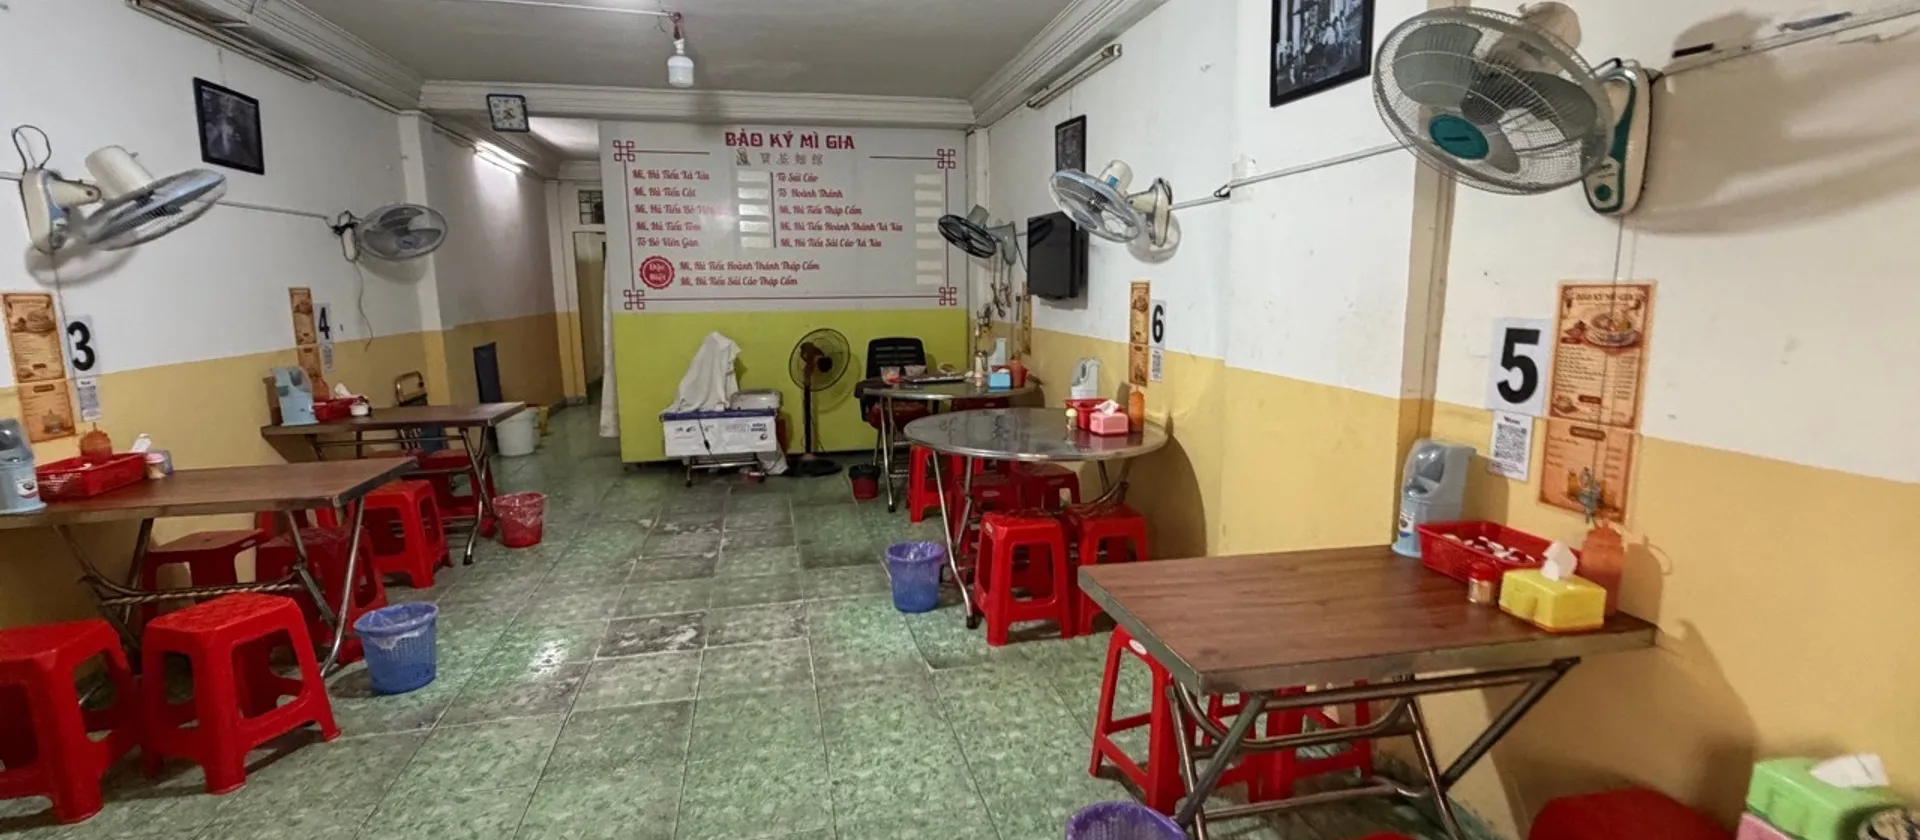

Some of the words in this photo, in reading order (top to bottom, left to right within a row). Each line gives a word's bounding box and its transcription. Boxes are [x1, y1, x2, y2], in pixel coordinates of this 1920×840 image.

[725, 128, 763, 147] BẢO
[770, 130, 793, 149] KÝ
[800, 131, 819, 149] MÌ
[826, 135, 855, 150] GIA
[319, 307, 330, 340] 4
[1152, 304, 1164, 344] 6
[67, 321, 96, 371] 3
[1496, 327, 1541, 405] 5
